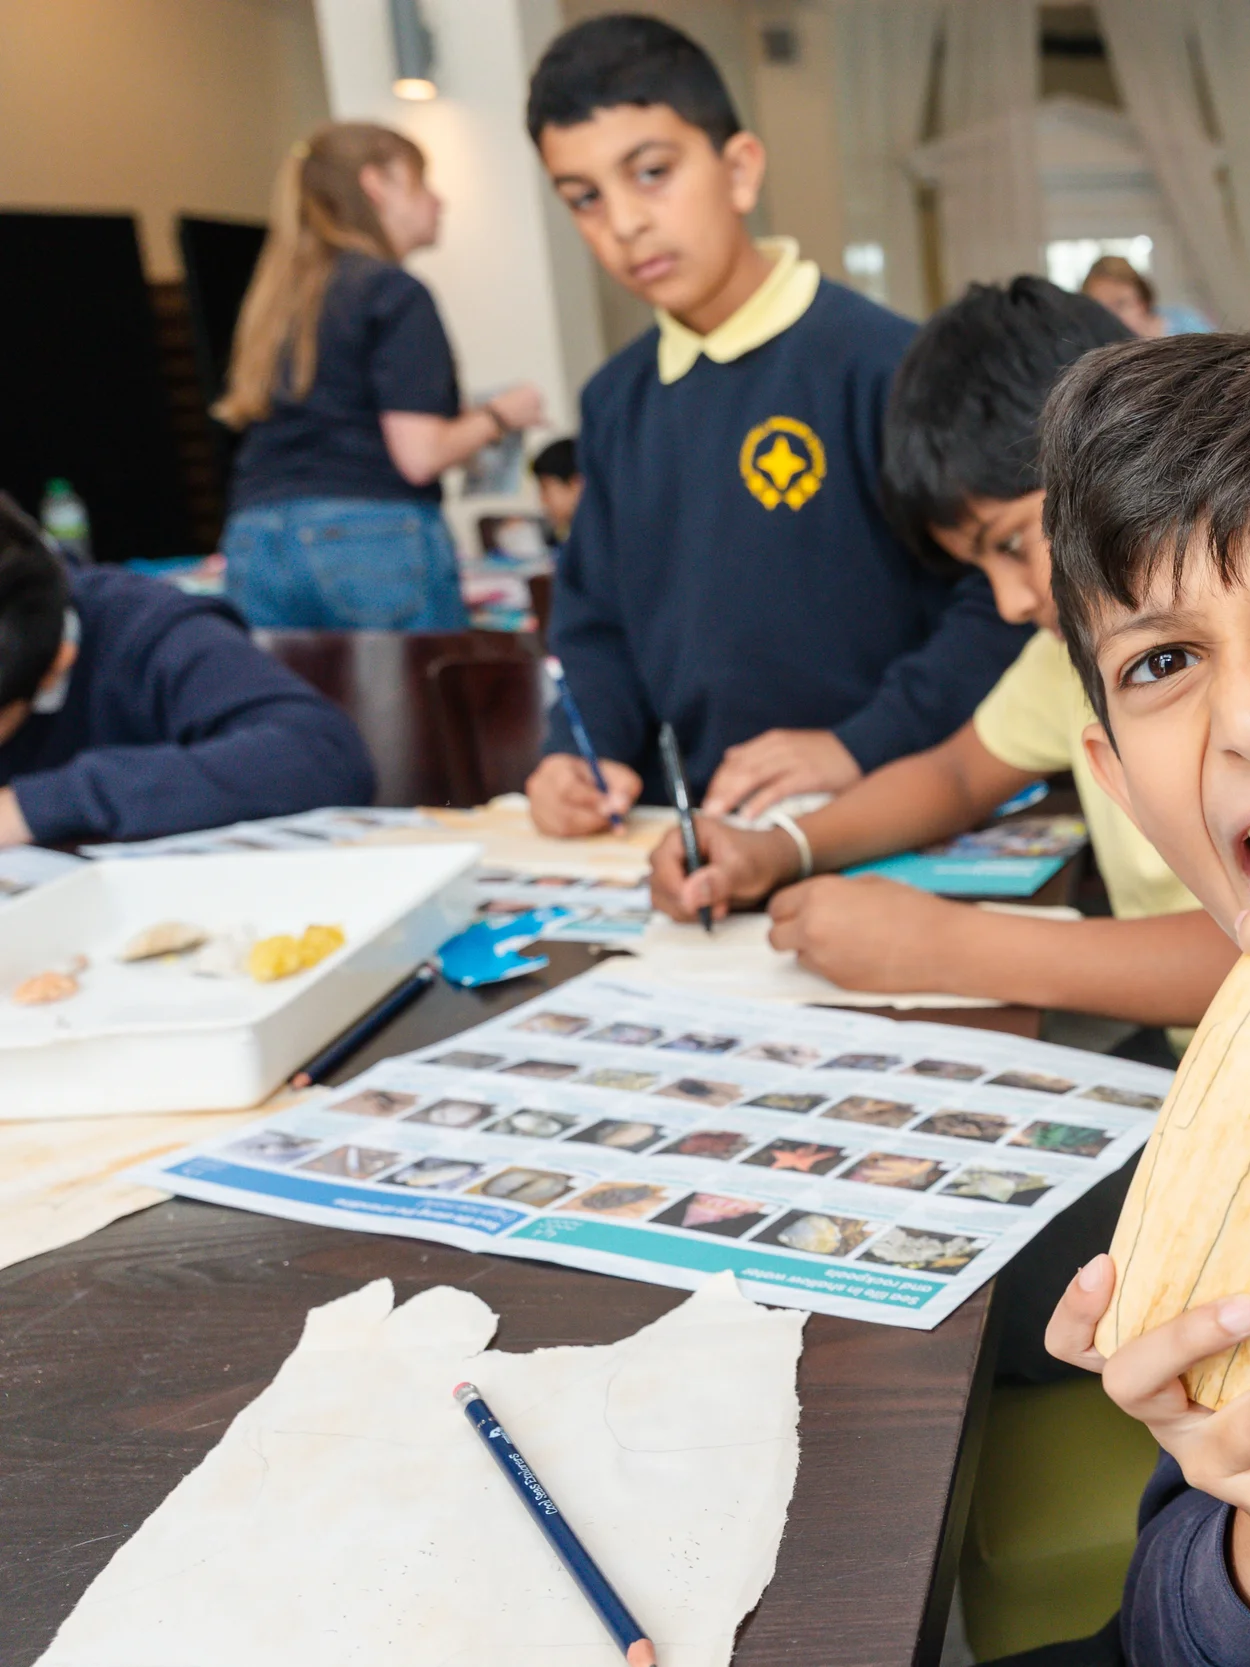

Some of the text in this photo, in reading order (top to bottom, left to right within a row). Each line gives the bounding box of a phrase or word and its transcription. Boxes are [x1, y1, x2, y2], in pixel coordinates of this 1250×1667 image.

[741, 1267, 920, 1305] Sea life in shallow water
[899, 1281, 933, 1293] and
[529, 1483, 547, 1501] Seas
[537, 1499, 558, 1515] Cool
